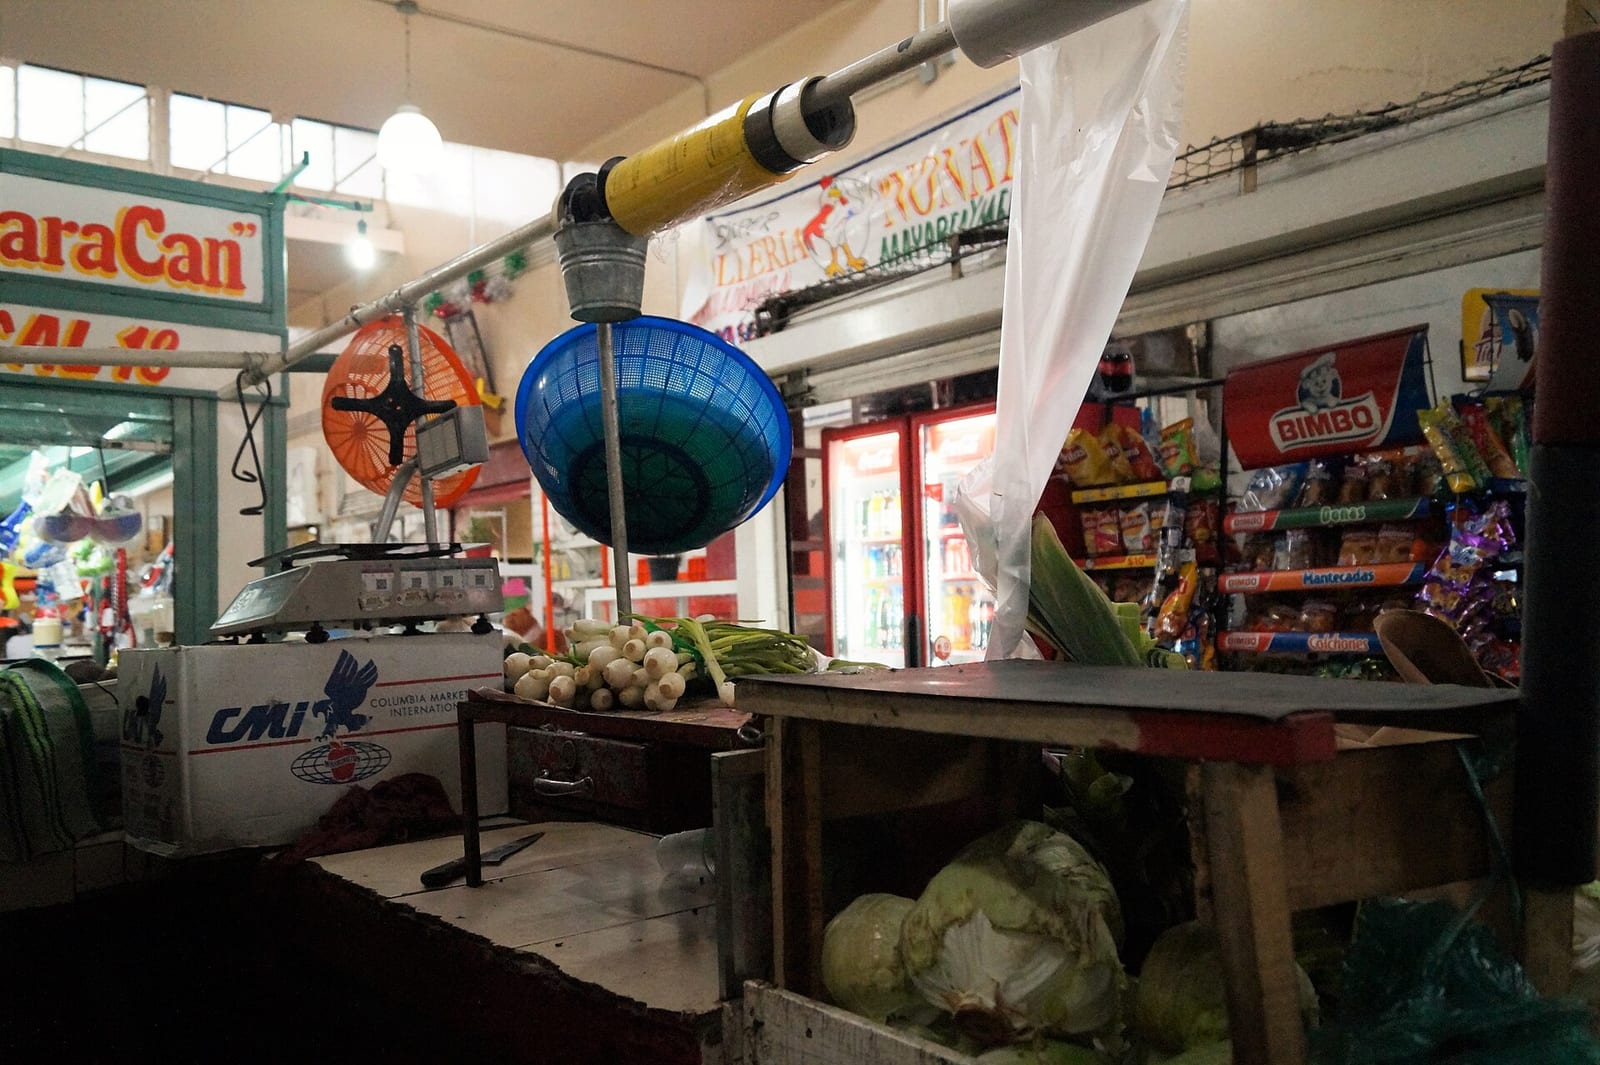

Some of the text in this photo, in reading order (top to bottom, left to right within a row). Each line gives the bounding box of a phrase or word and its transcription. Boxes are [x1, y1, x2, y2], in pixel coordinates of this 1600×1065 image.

[1276, 404, 1375, 442] BIMBO
[1320, 506, 1366, 524] Donas
[1303, 568, 1375, 585] Mantecadas
[1307, 633, 1370, 651] Colchones
[370, 694, 427, 708] COLUMBIA
